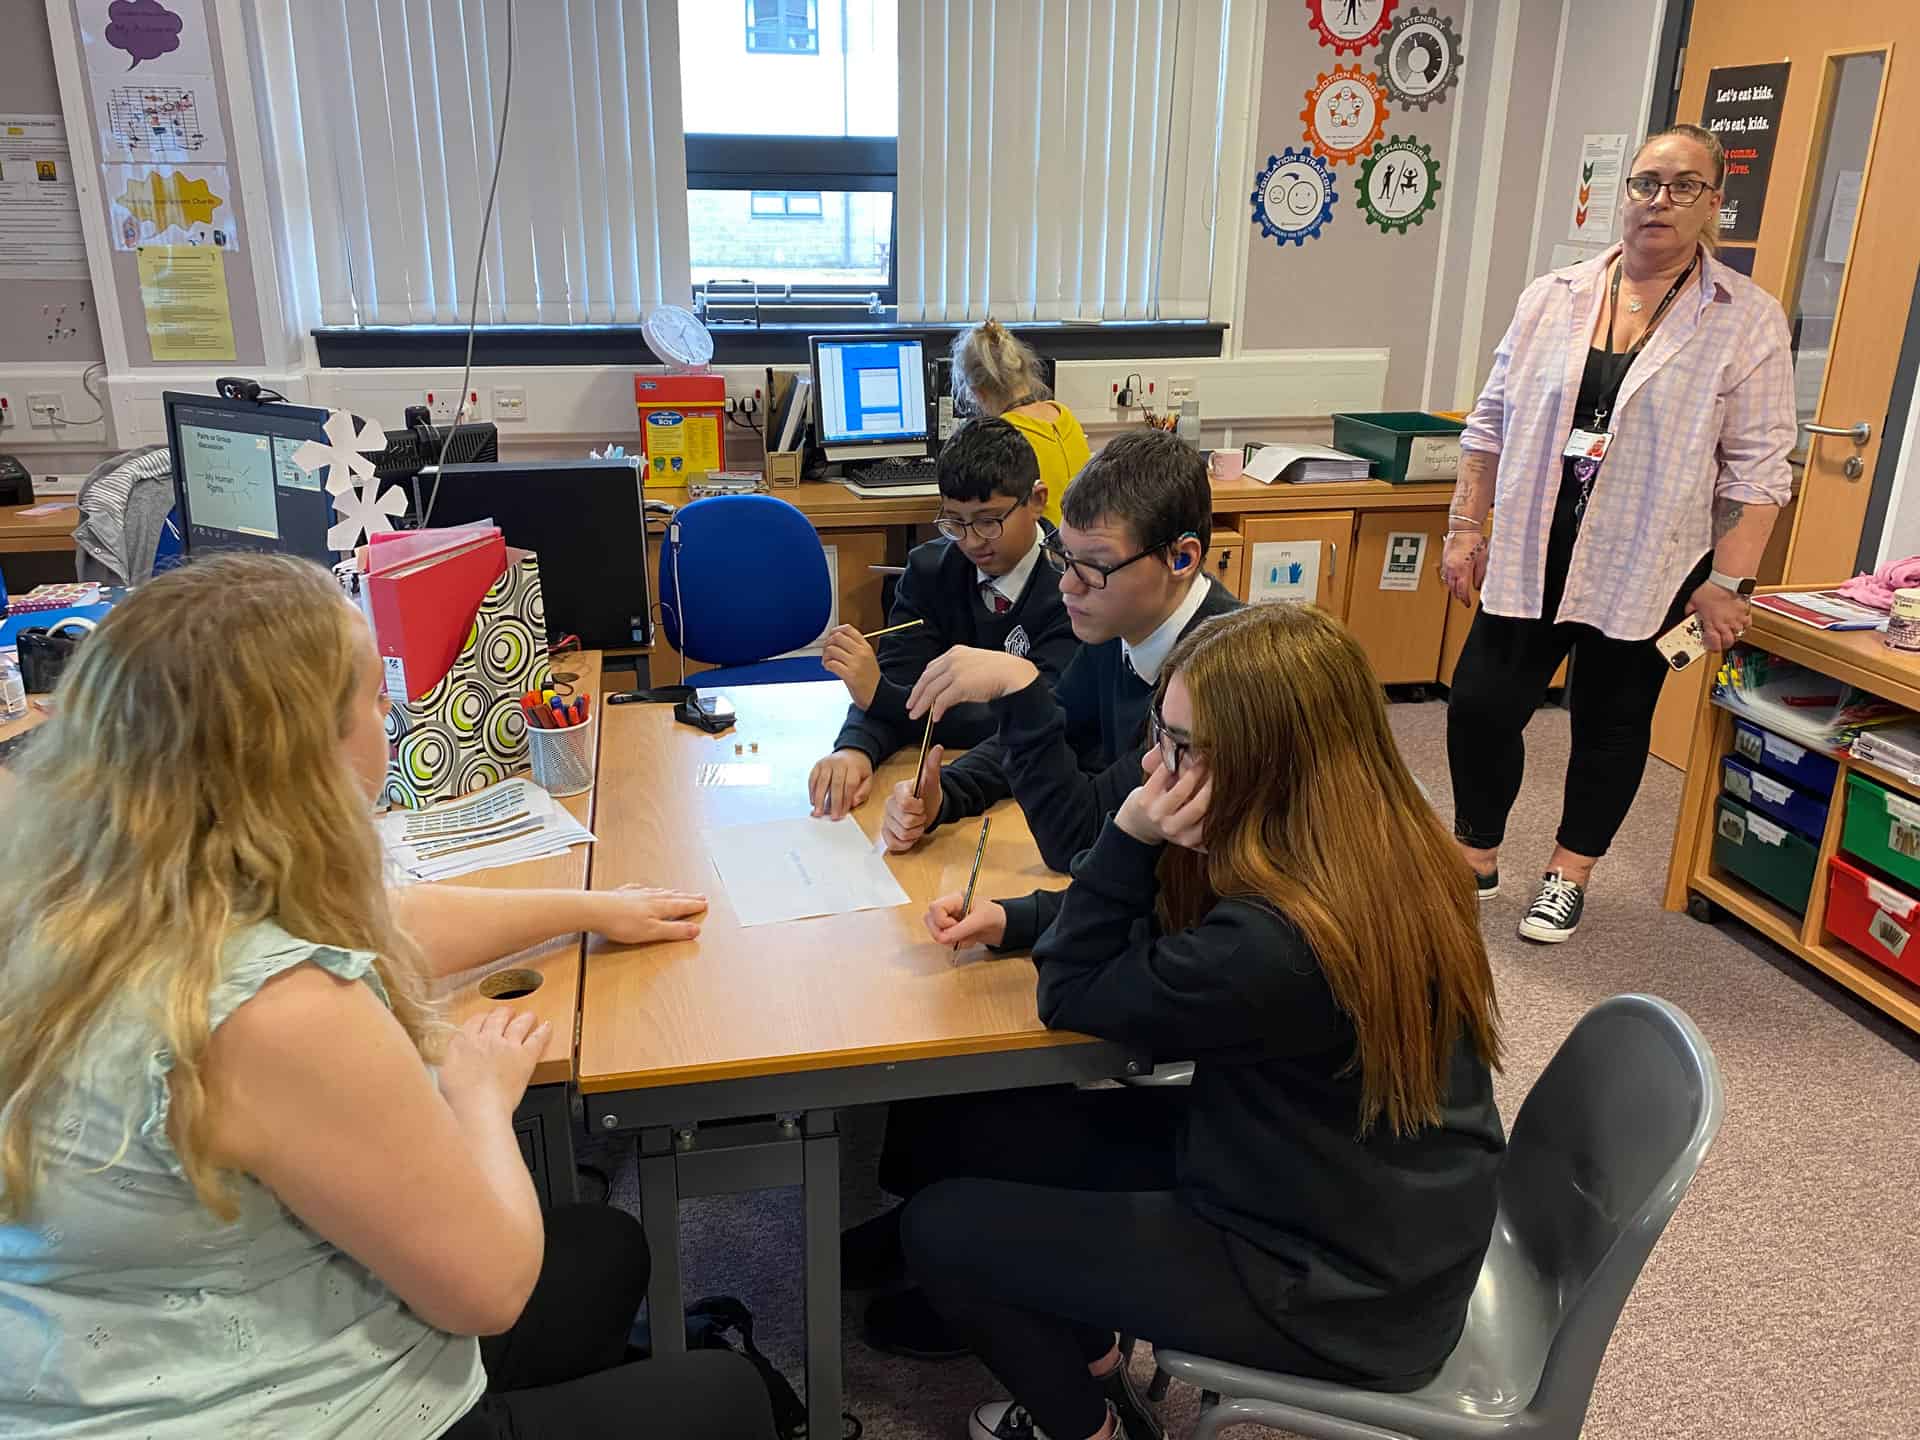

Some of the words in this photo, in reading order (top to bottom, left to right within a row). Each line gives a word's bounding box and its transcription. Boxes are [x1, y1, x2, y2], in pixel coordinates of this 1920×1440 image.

[1400, 15, 1445, 30] INTENSITY
[1312, 71, 1351, 101] EMOTION
[1352, 71, 1380, 100] WORDS
[1716, 88, 1738, 103] Let's
[1738, 87, 1752, 101] eat
[1752, 85, 1774, 100] kids.
[1710, 118, 1731, 132] Let's
[1731, 118, 1746, 135] eat,
[1747, 116, 1769, 130] kids.
[1375, 143, 1428, 162] BEHAVIOURS
[1257, 155, 1297, 202] REGULATION
[1300, 155, 1331, 203] STRATEGIES
